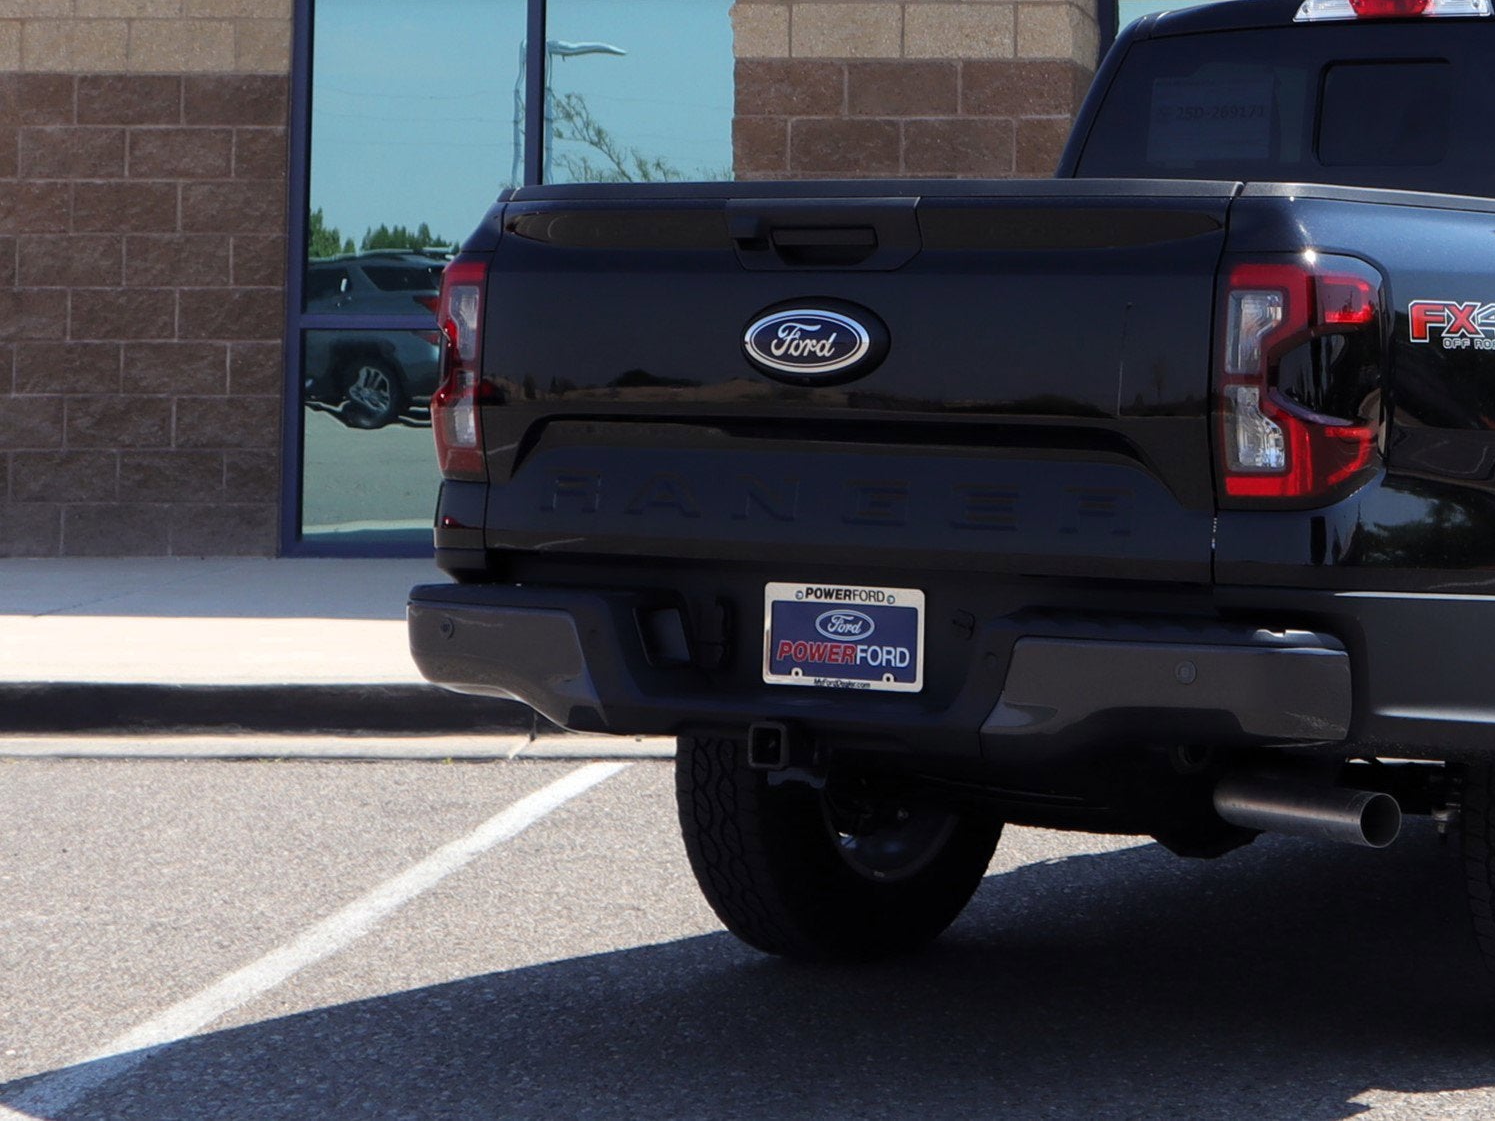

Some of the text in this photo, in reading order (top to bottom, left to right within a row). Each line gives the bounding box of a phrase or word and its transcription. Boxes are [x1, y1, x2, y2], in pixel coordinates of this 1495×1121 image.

[771, 322, 837, 357] Ford
[1443, 338, 1470, 349] OFF
[540, 465, 1136, 537] RANGER
[805, 587, 885, 603] POWERFORD
[827, 614, 863, 634] Ford
[777, 640, 910, 667] POWERFORD
